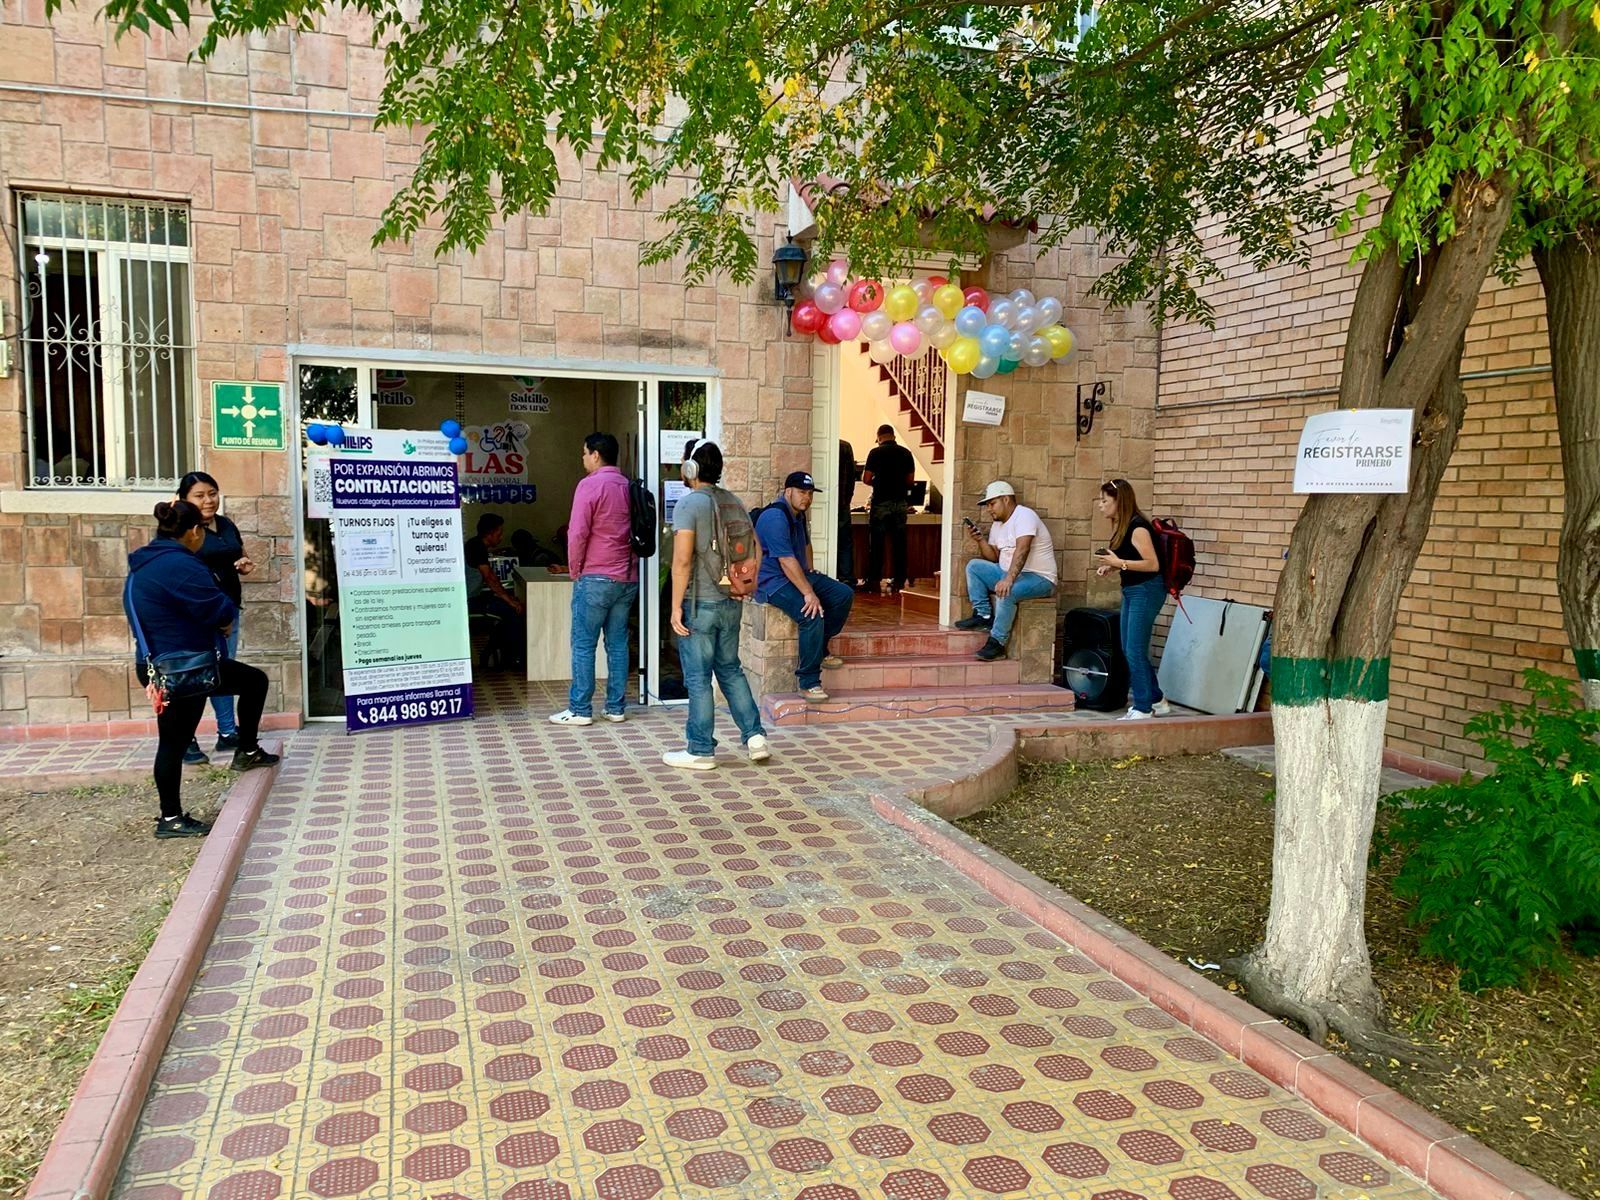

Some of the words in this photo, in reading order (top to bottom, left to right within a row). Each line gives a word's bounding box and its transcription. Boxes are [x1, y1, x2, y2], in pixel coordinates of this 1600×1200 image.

[378, 391, 413, 405] ltillo
[510, 393, 549, 404] Saltillo
[511, 404, 528, 412] nos
[221, 437, 242, 445] PUNTO
[242, 437, 251, 446] DE
[333, 435, 373, 450] HILLIPS
[1304, 446, 1403, 459] REGISTRARSE
[334, 463, 354, 476] POR
[356, 462, 411, 477] EXPANSIÓN
[412, 465, 454, 477] ABRIMOS
[1355, 459, 1392, 468] PRIMERO
[334, 479, 456, 494] CONTRATACIONES
[336, 497, 358, 505] Nuevas
[392, 498, 429, 507] prestaciones
[339, 518, 371, 527] TURNOS
[373, 518, 395, 527] FIJOS
[407, 517, 420, 528] ¡Tu
[421, 516, 443, 528] eliges
[445, 517, 453, 526] el
[412, 531, 433, 539] turno
[434, 532, 449, 541] que
[415, 542, 447, 554] quieras!
[407, 556, 434, 566] Operador
[435, 556, 457, 564] General
[358, 657, 372, 665] Pago
[372, 655, 396, 663] semanal
[404, 653, 422, 662] jueves
[357, 696, 373, 706] Para
[374, 694, 404, 706] mayores
[404, 690, 434, 702] informes
[434, 688, 453, 698] llama
[454, 687, 461, 696] al
[369, 704, 398, 723] 844
[400, 701, 428, 720] 986
[430, 699, 448, 716] 92
[448, 697, 462, 714] 17
